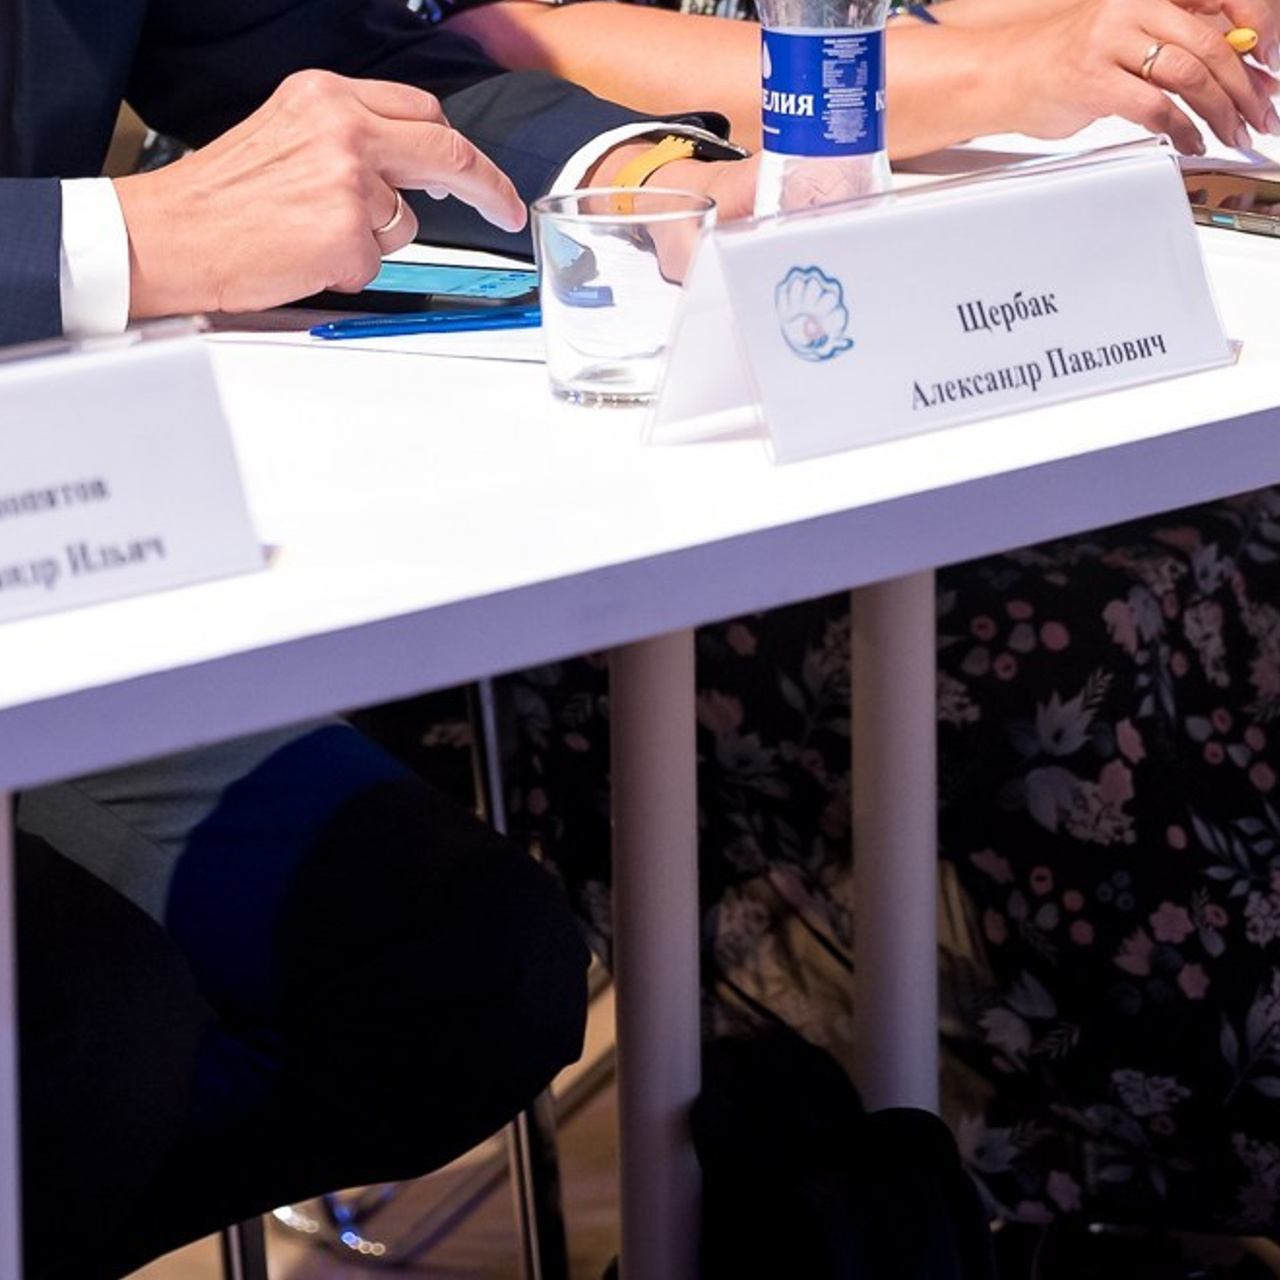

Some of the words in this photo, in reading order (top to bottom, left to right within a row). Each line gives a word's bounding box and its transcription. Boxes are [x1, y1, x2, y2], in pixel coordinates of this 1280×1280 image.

[956, 291, 1059, 333] Щербак
[912, 360, 1042, 411] Александр
[1045, 333, 1168, 379] Павлович
